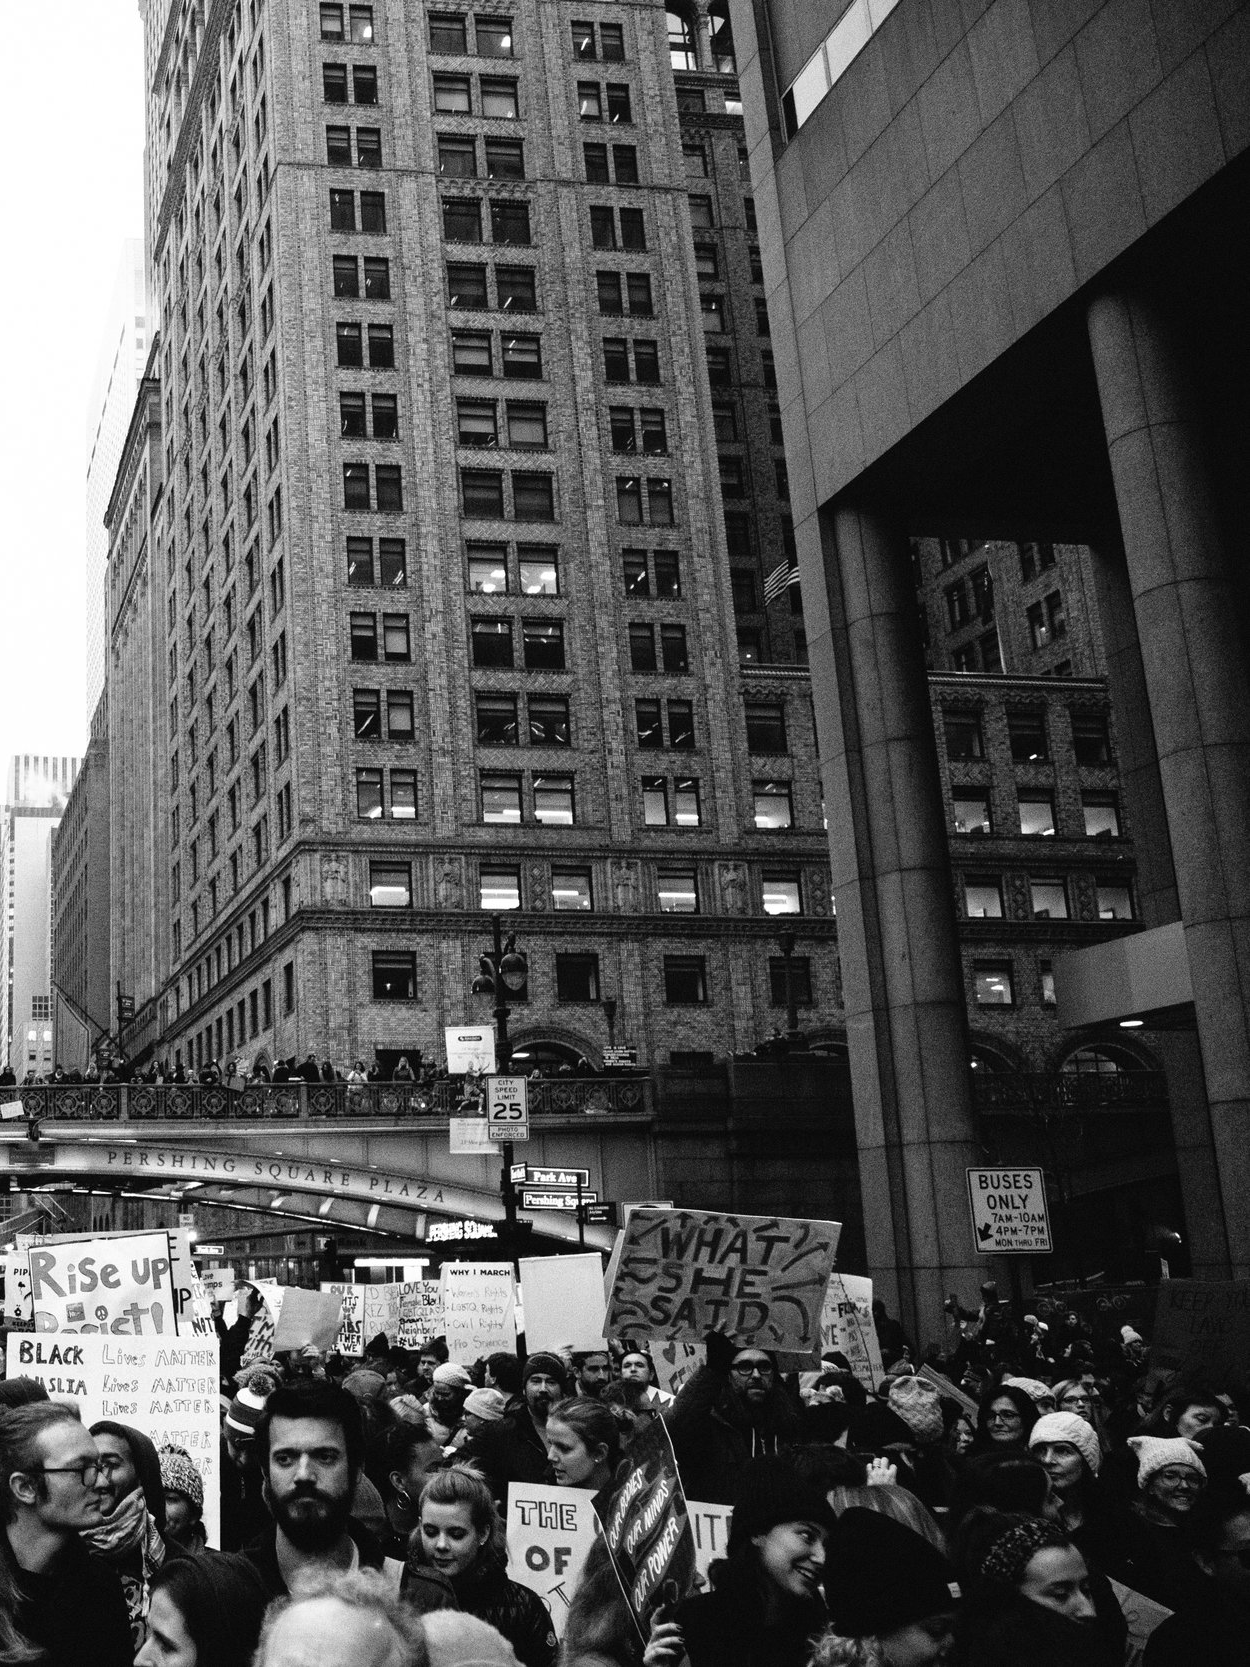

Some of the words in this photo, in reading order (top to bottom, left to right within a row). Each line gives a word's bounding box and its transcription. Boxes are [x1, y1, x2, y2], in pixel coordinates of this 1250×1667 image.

[493, 1102, 523, 1120] 25
[107, 1150, 238, 1174] PERSHING
[254, 1161, 351, 1188] SQUARE
[368, 1178, 446, 1204] PLAZA
[533, 1171, 557, 1183] Park
[557, 1172, 578, 1183] Ave
[978, 1174, 1033, 1190] BUSES
[525, 1194, 564, 1208] Pershing
[986, 1193, 1029, 1210] ONLY
[991, 1212, 1045, 1223] 7AM-10AM
[995, 1224, 1045, 1236] 4PM-7PM
[660, 1225, 791, 1266] WHAT
[995, 1239, 1013, 1247] MON
[1014, 1239, 1033, 1247] THRU
[1034, 1237, 1048, 1246] FRI
[13, 1268, 30, 1276] PIP
[479, 1269, 511, 1277] MARCH
[657, 1261, 769, 1299] SHE
[398, 1281, 421, 1296] LOVE
[451, 1302, 479, 1313] LGBTQ
[480, 1303, 504, 1315] Rights
[649, 1295, 770, 1335] SAID
[452, 1317, 474, 1330] Civil
[478, 1318, 504, 1333] Rights
[19, 1339, 84, 1365] BLACK
[102, 1343, 146, 1366] Lives
[154, 1349, 217, 1368] MATTER
[102, 1374, 139, 1393] Lives
[151, 1376, 217, 1395] MATTER
[102, 1400, 138, 1416] Lives
[149, 1399, 215, 1415] MATTER
[149, 1429, 212, 1449] MATTER
[515, 1499, 578, 1532] THE
[610, 1511, 623, 1549] OUR
[620, 1467, 643, 1519] BODIES
[626, 1519, 643, 1554] OUR
[643, 1480, 669, 1531] MINDS
[525, 1544, 572, 1576] OF
[634, 1568, 650, 1613] OUR
[647, 1516, 679, 1582] POWER
